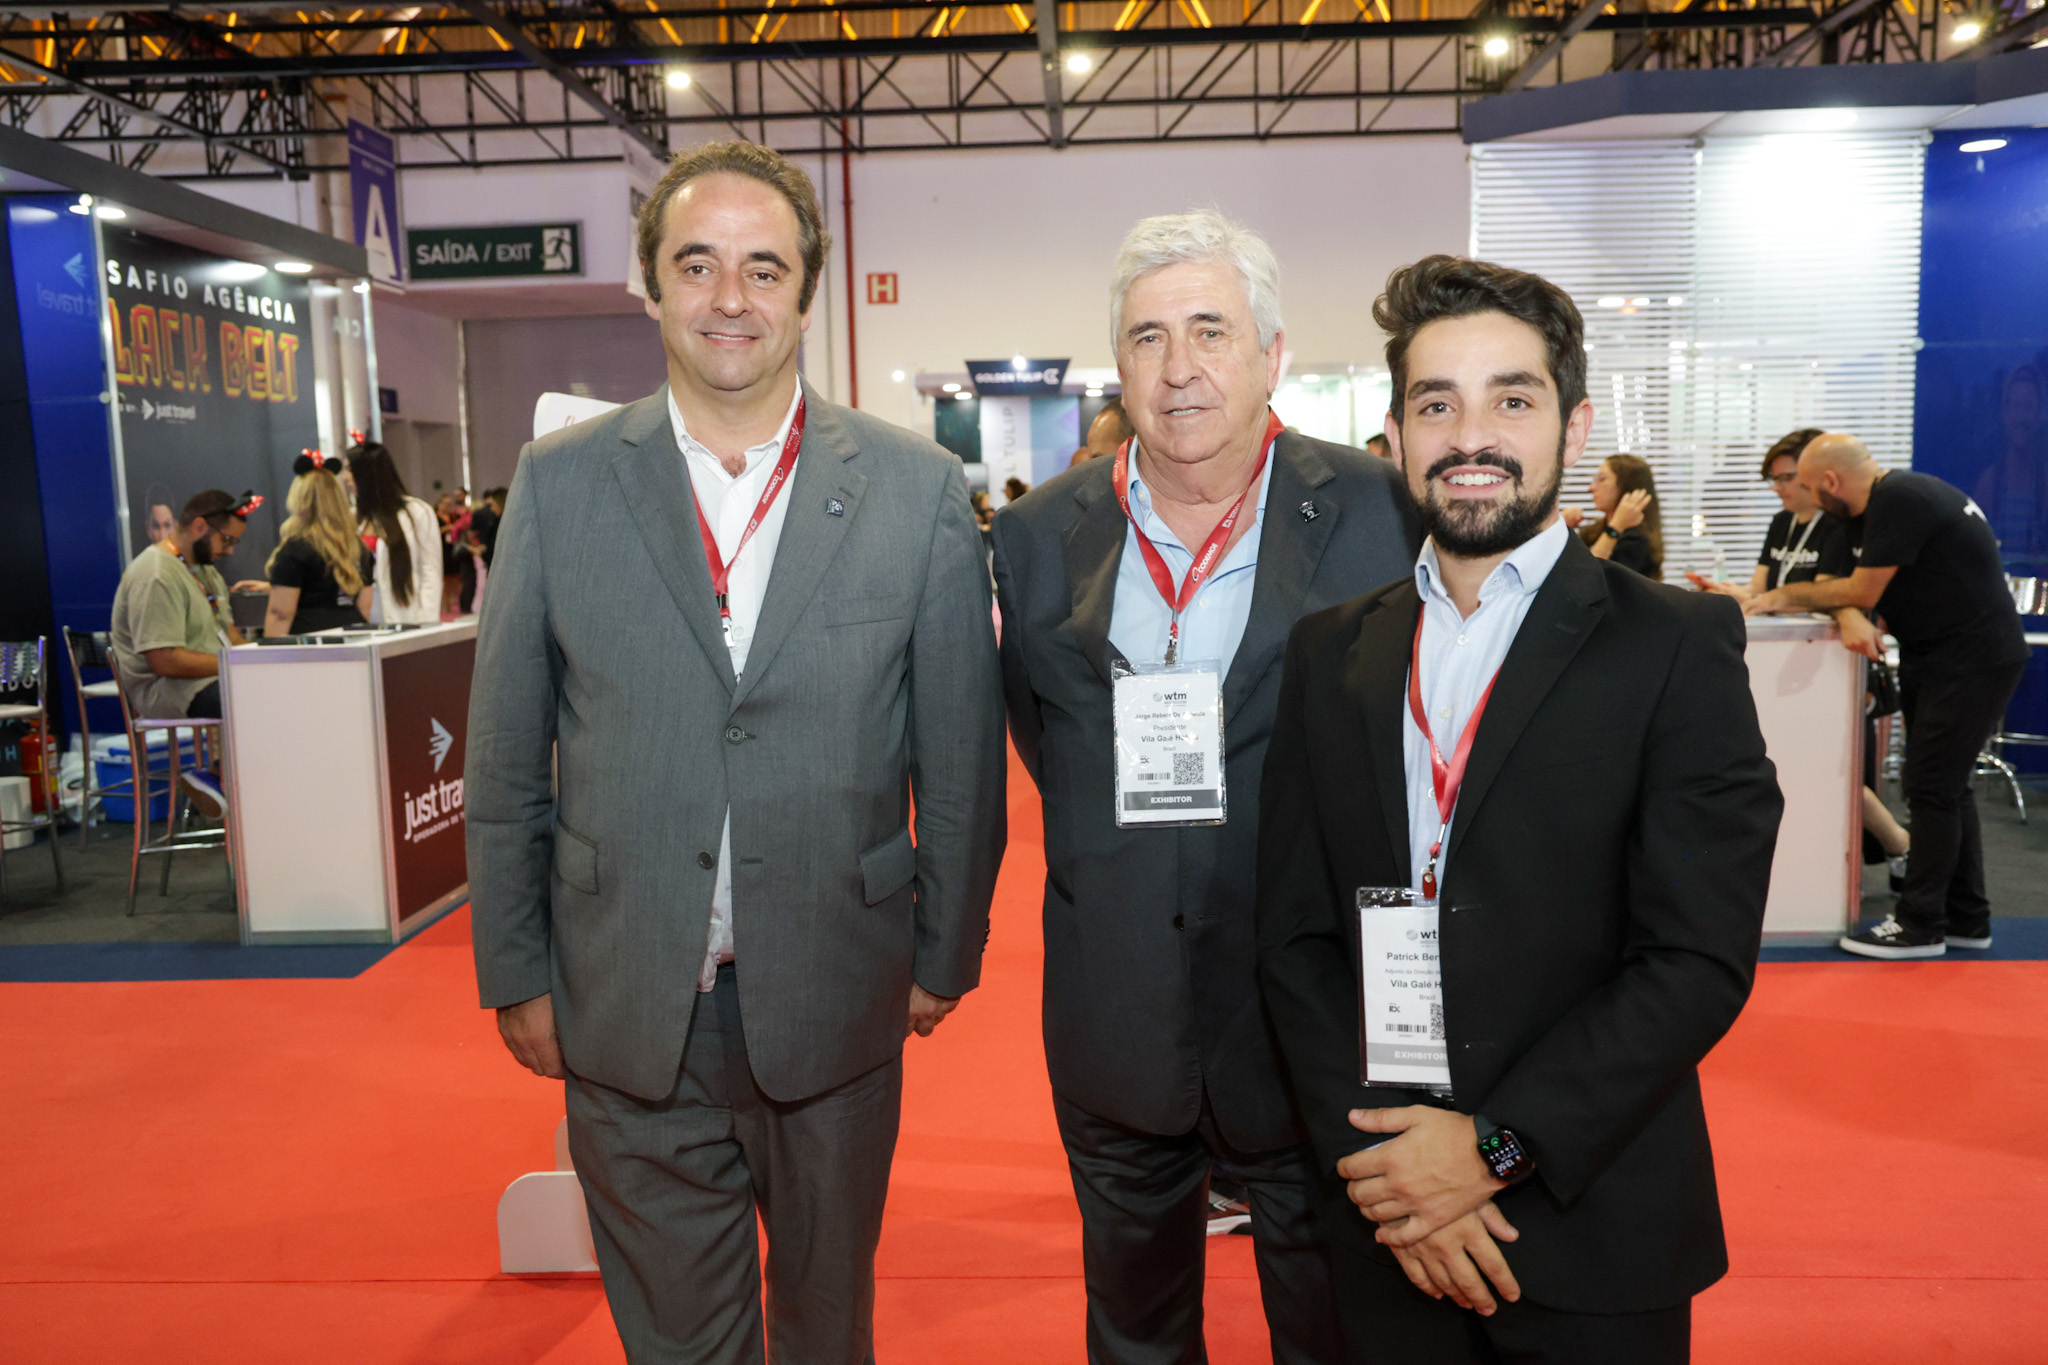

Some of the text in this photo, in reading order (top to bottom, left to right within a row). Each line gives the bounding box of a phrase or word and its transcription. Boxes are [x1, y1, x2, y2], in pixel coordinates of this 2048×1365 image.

[364, 183, 398, 278] A
[416, 238, 479, 265] SAÍDA
[496, 242, 533, 262] EXIT
[107, 260, 296, 324] SAFIO AGÊNCIA
[871, 274, 894, 302] H
[220, 321, 299, 402] BELT
[1003, 405, 1017, 458] TULIP
[1198, 542, 1219, 574] CODEMGE
[1164, 692, 1187, 701] wtm
[404, 778, 464, 840] just tra
[1150, 796, 1192, 804] EXHIBITOR
[1386, 952, 1419, 961] Patrick
[1390, 979, 1408, 988] Vila
[1410, 979, 1432, 989] Galé
[1394, 1050, 1447, 1061] EXHIBITOR
